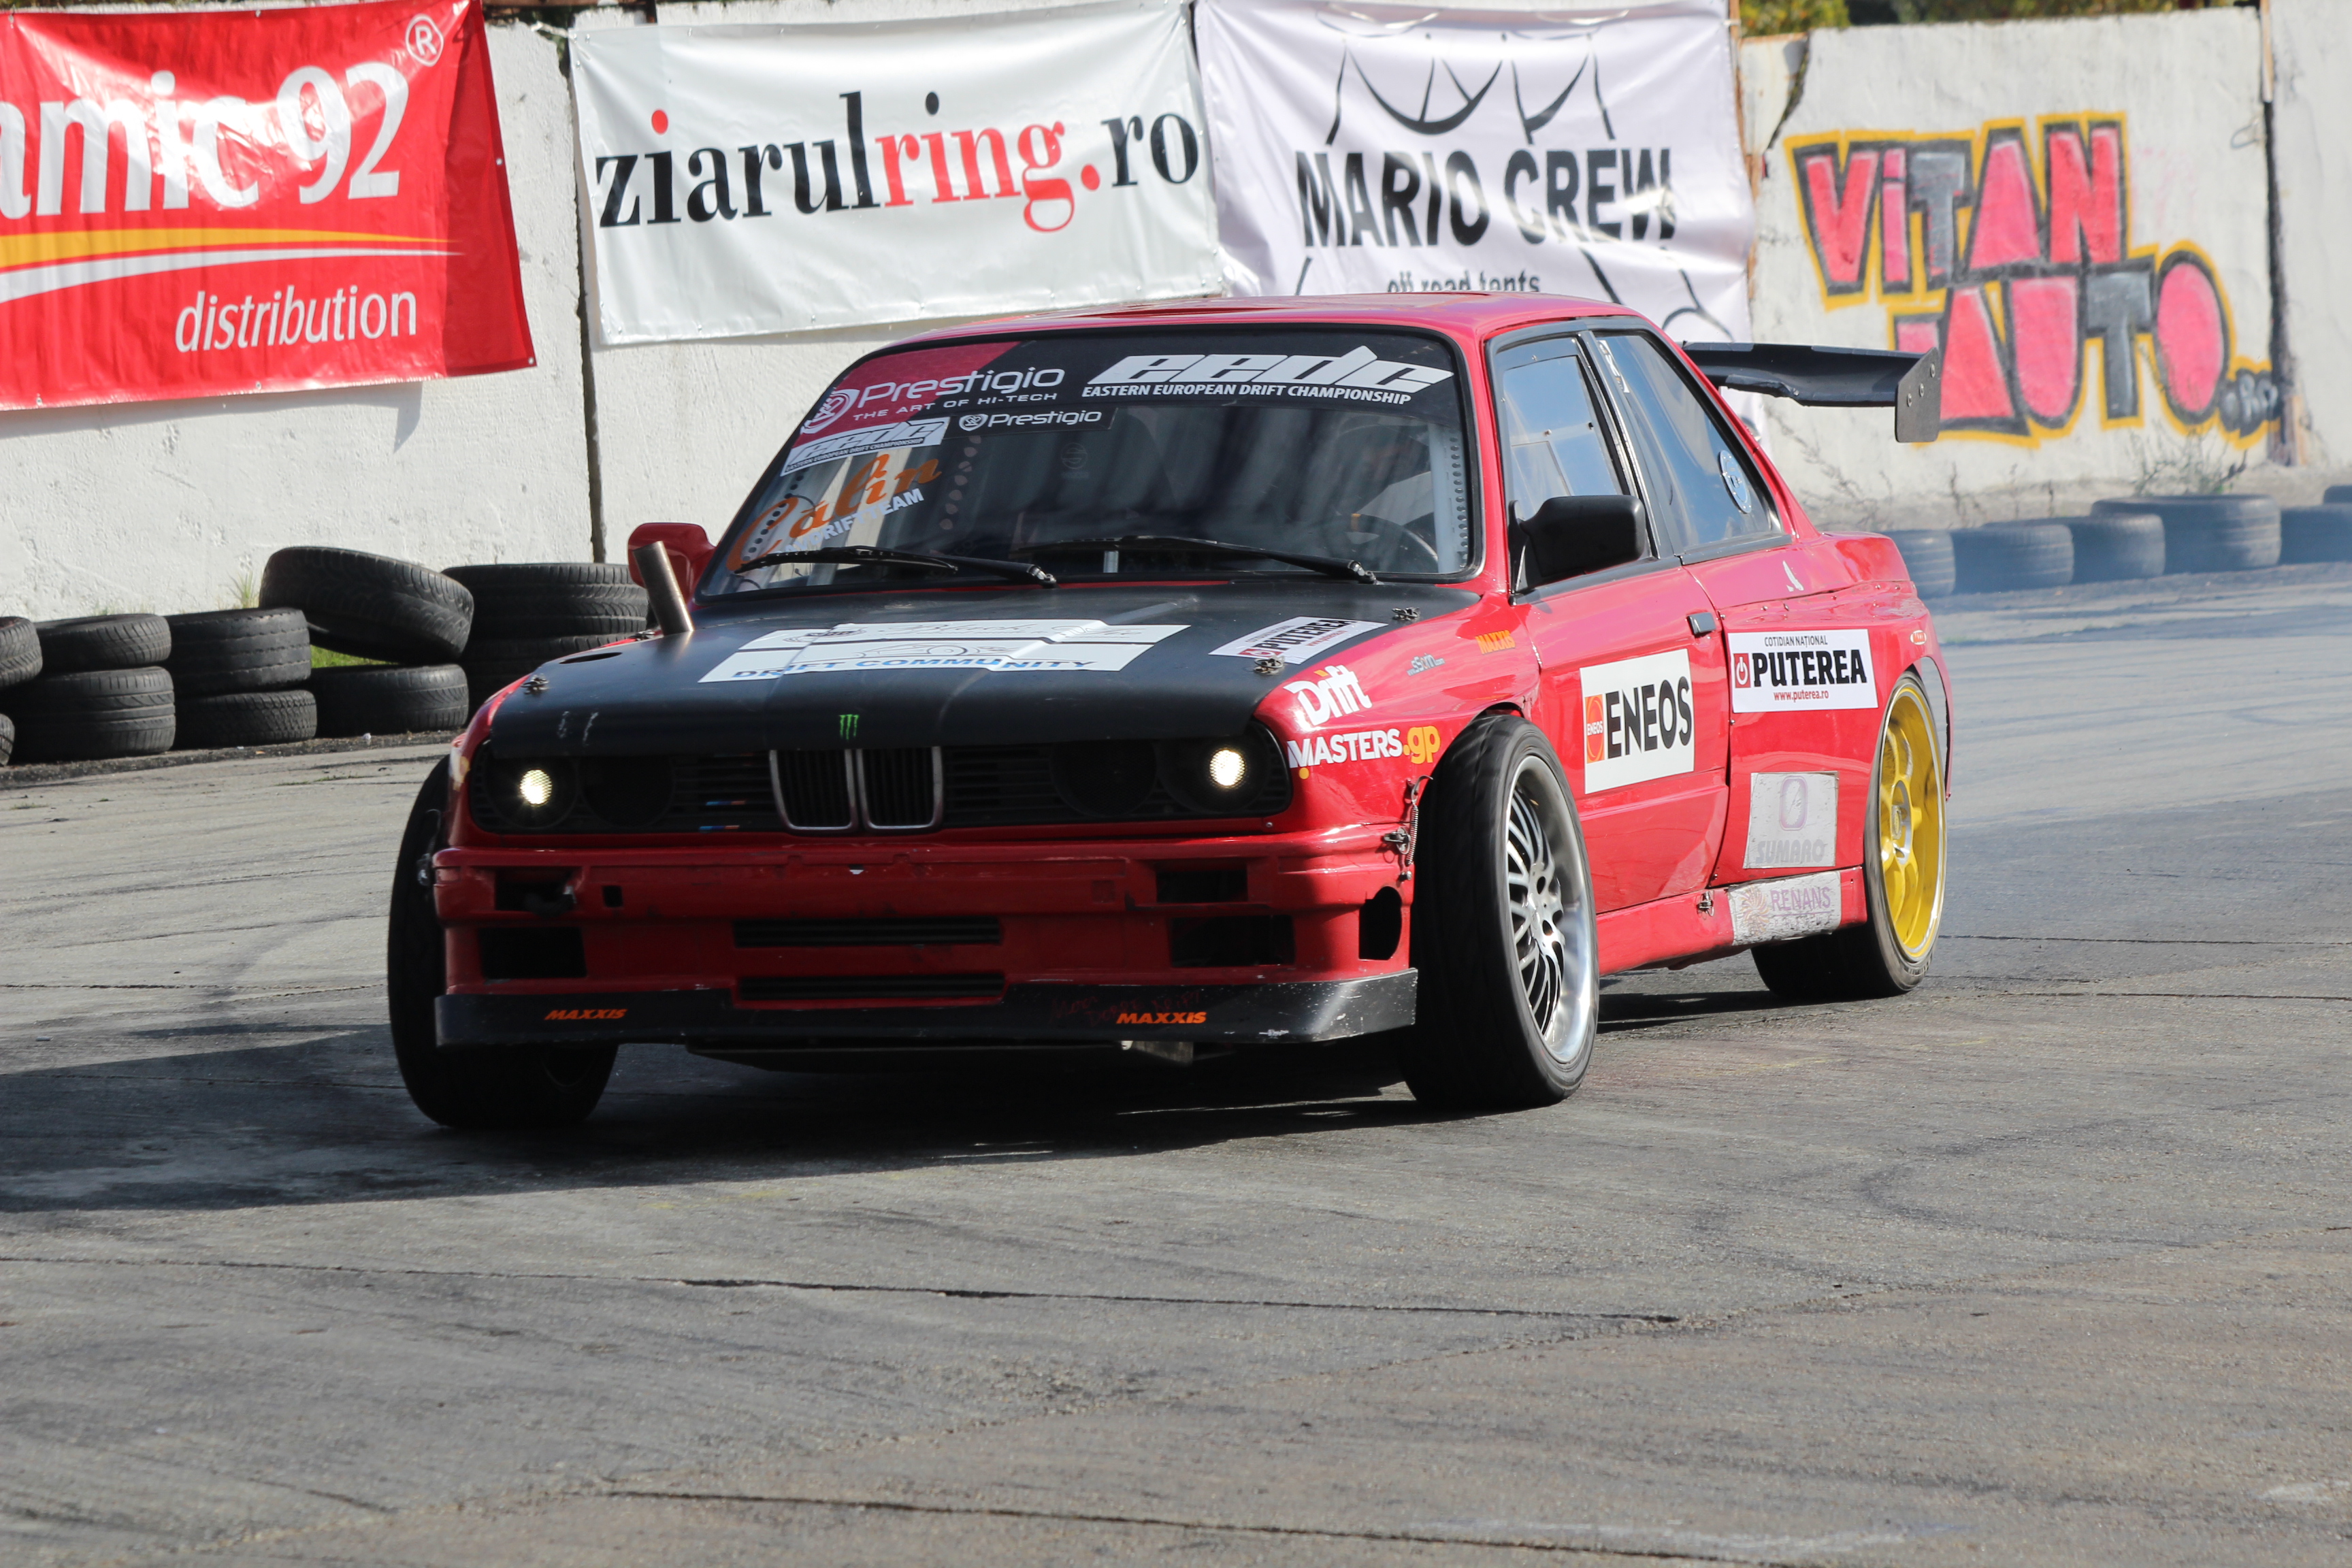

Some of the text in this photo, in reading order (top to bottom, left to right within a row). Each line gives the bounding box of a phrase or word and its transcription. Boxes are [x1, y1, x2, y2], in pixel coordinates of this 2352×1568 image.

[275, 62, 410, 205] 92
[595, 91, 1199, 233] ziarulring.ro
[1295, 148, 1677, 247] MARIO CREW
[175, 285, 416, 353] distribution
[858, 367, 1066, 408] Prestigio
[1081, 383, 1411, 406] EASTERN EUROPEAN DRIFT CHAMPIONSHIP
[853, 392, 1058, 421] THE ART OF HI-TECH
[987, 410, 1102, 428] Prestigio
[1252, 620, 1358, 651] PUTEREA
[1475, 630, 1516, 655] MAXXIS
[1764, 636, 1795, 647] COTIDIAN
[732, 658, 1098, 678] DRIFT COMMUNITY
[1752, 649, 1867, 687] PUTEREA
[1283, 665, 1373, 726] Drift
[1774, 689, 1829, 702] www.puterea.ro
[1587, 720, 1603, 736] ENEOS
[1605, 676, 1693, 760] ENEOS
[545, 1009, 627, 1020] MAXXIS
[1116, 1011, 1207, 1025] MAXXIS
